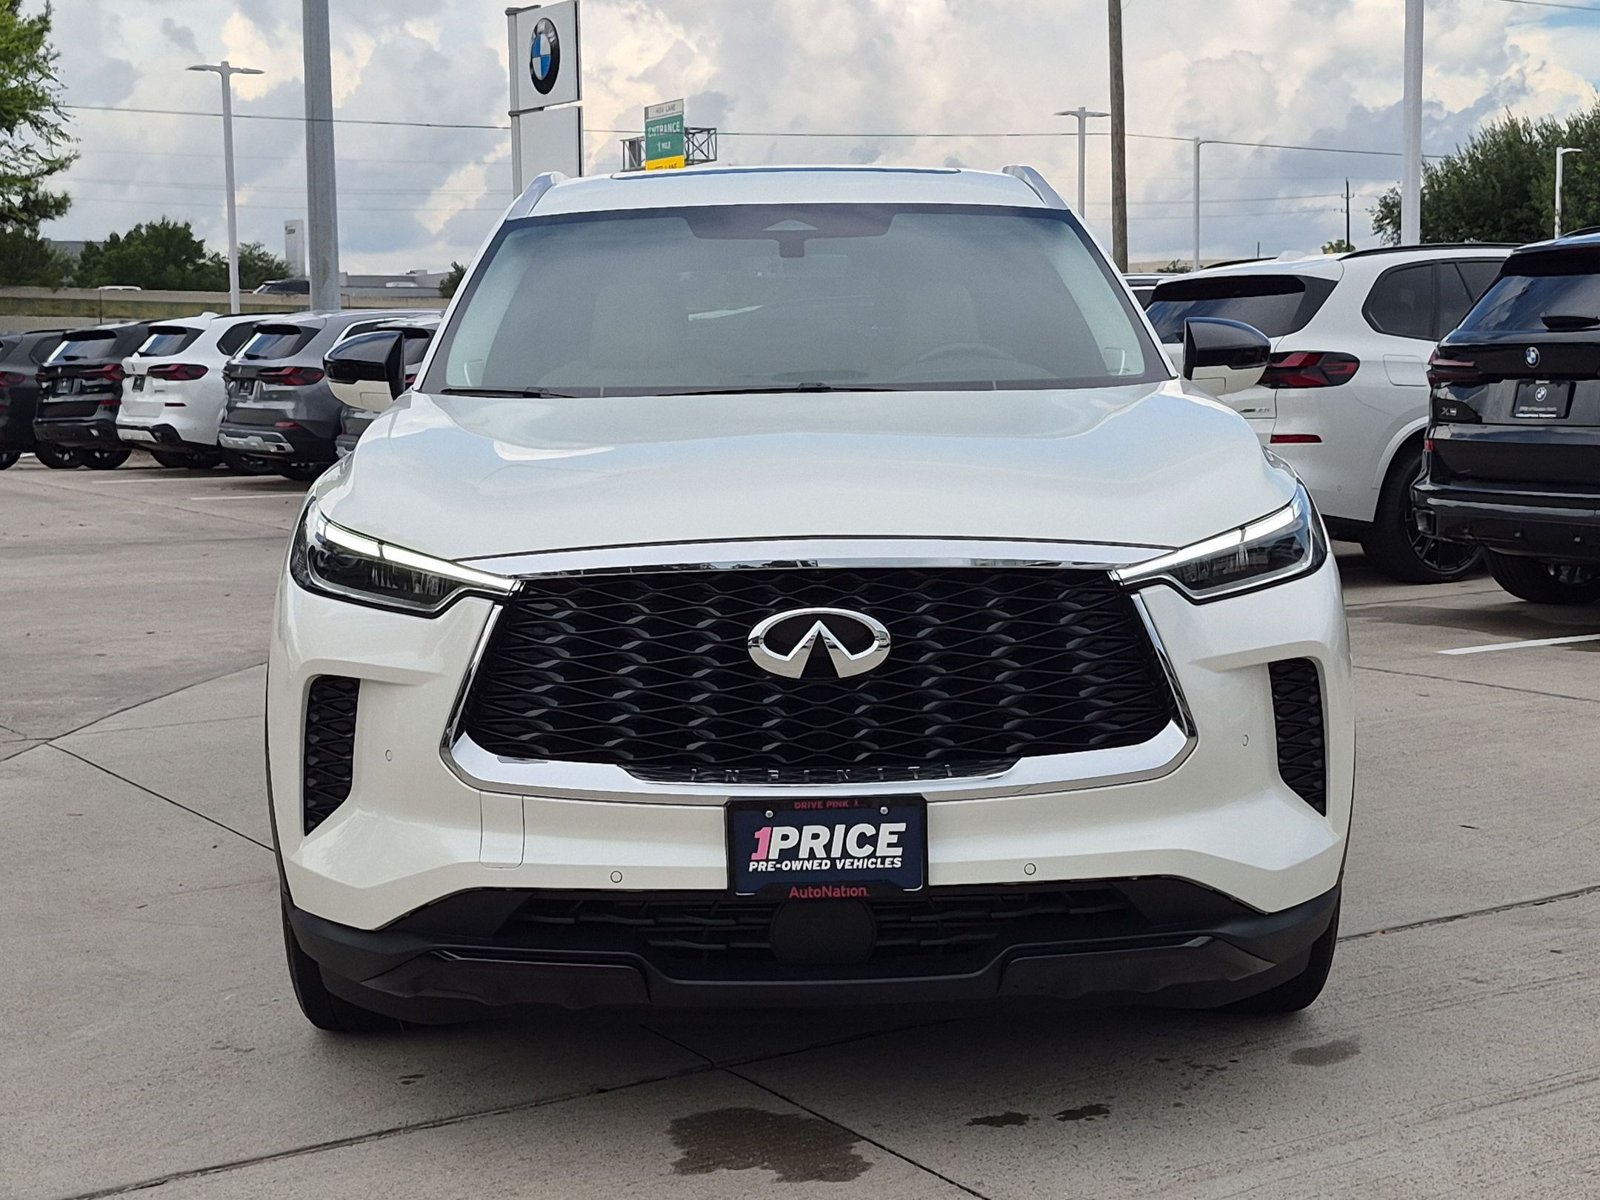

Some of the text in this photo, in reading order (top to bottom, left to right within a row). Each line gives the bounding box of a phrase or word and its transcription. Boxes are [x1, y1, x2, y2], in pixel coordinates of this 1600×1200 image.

[648, 121, 680, 137] ENTRANCE
[794, 800, 849, 810] DRIVE PINK
[751, 822, 907, 860] 1PRICE
[748, 857, 903, 872] PRE-OWNED VEHICLES
[789, 886, 867, 898] AutoNation
